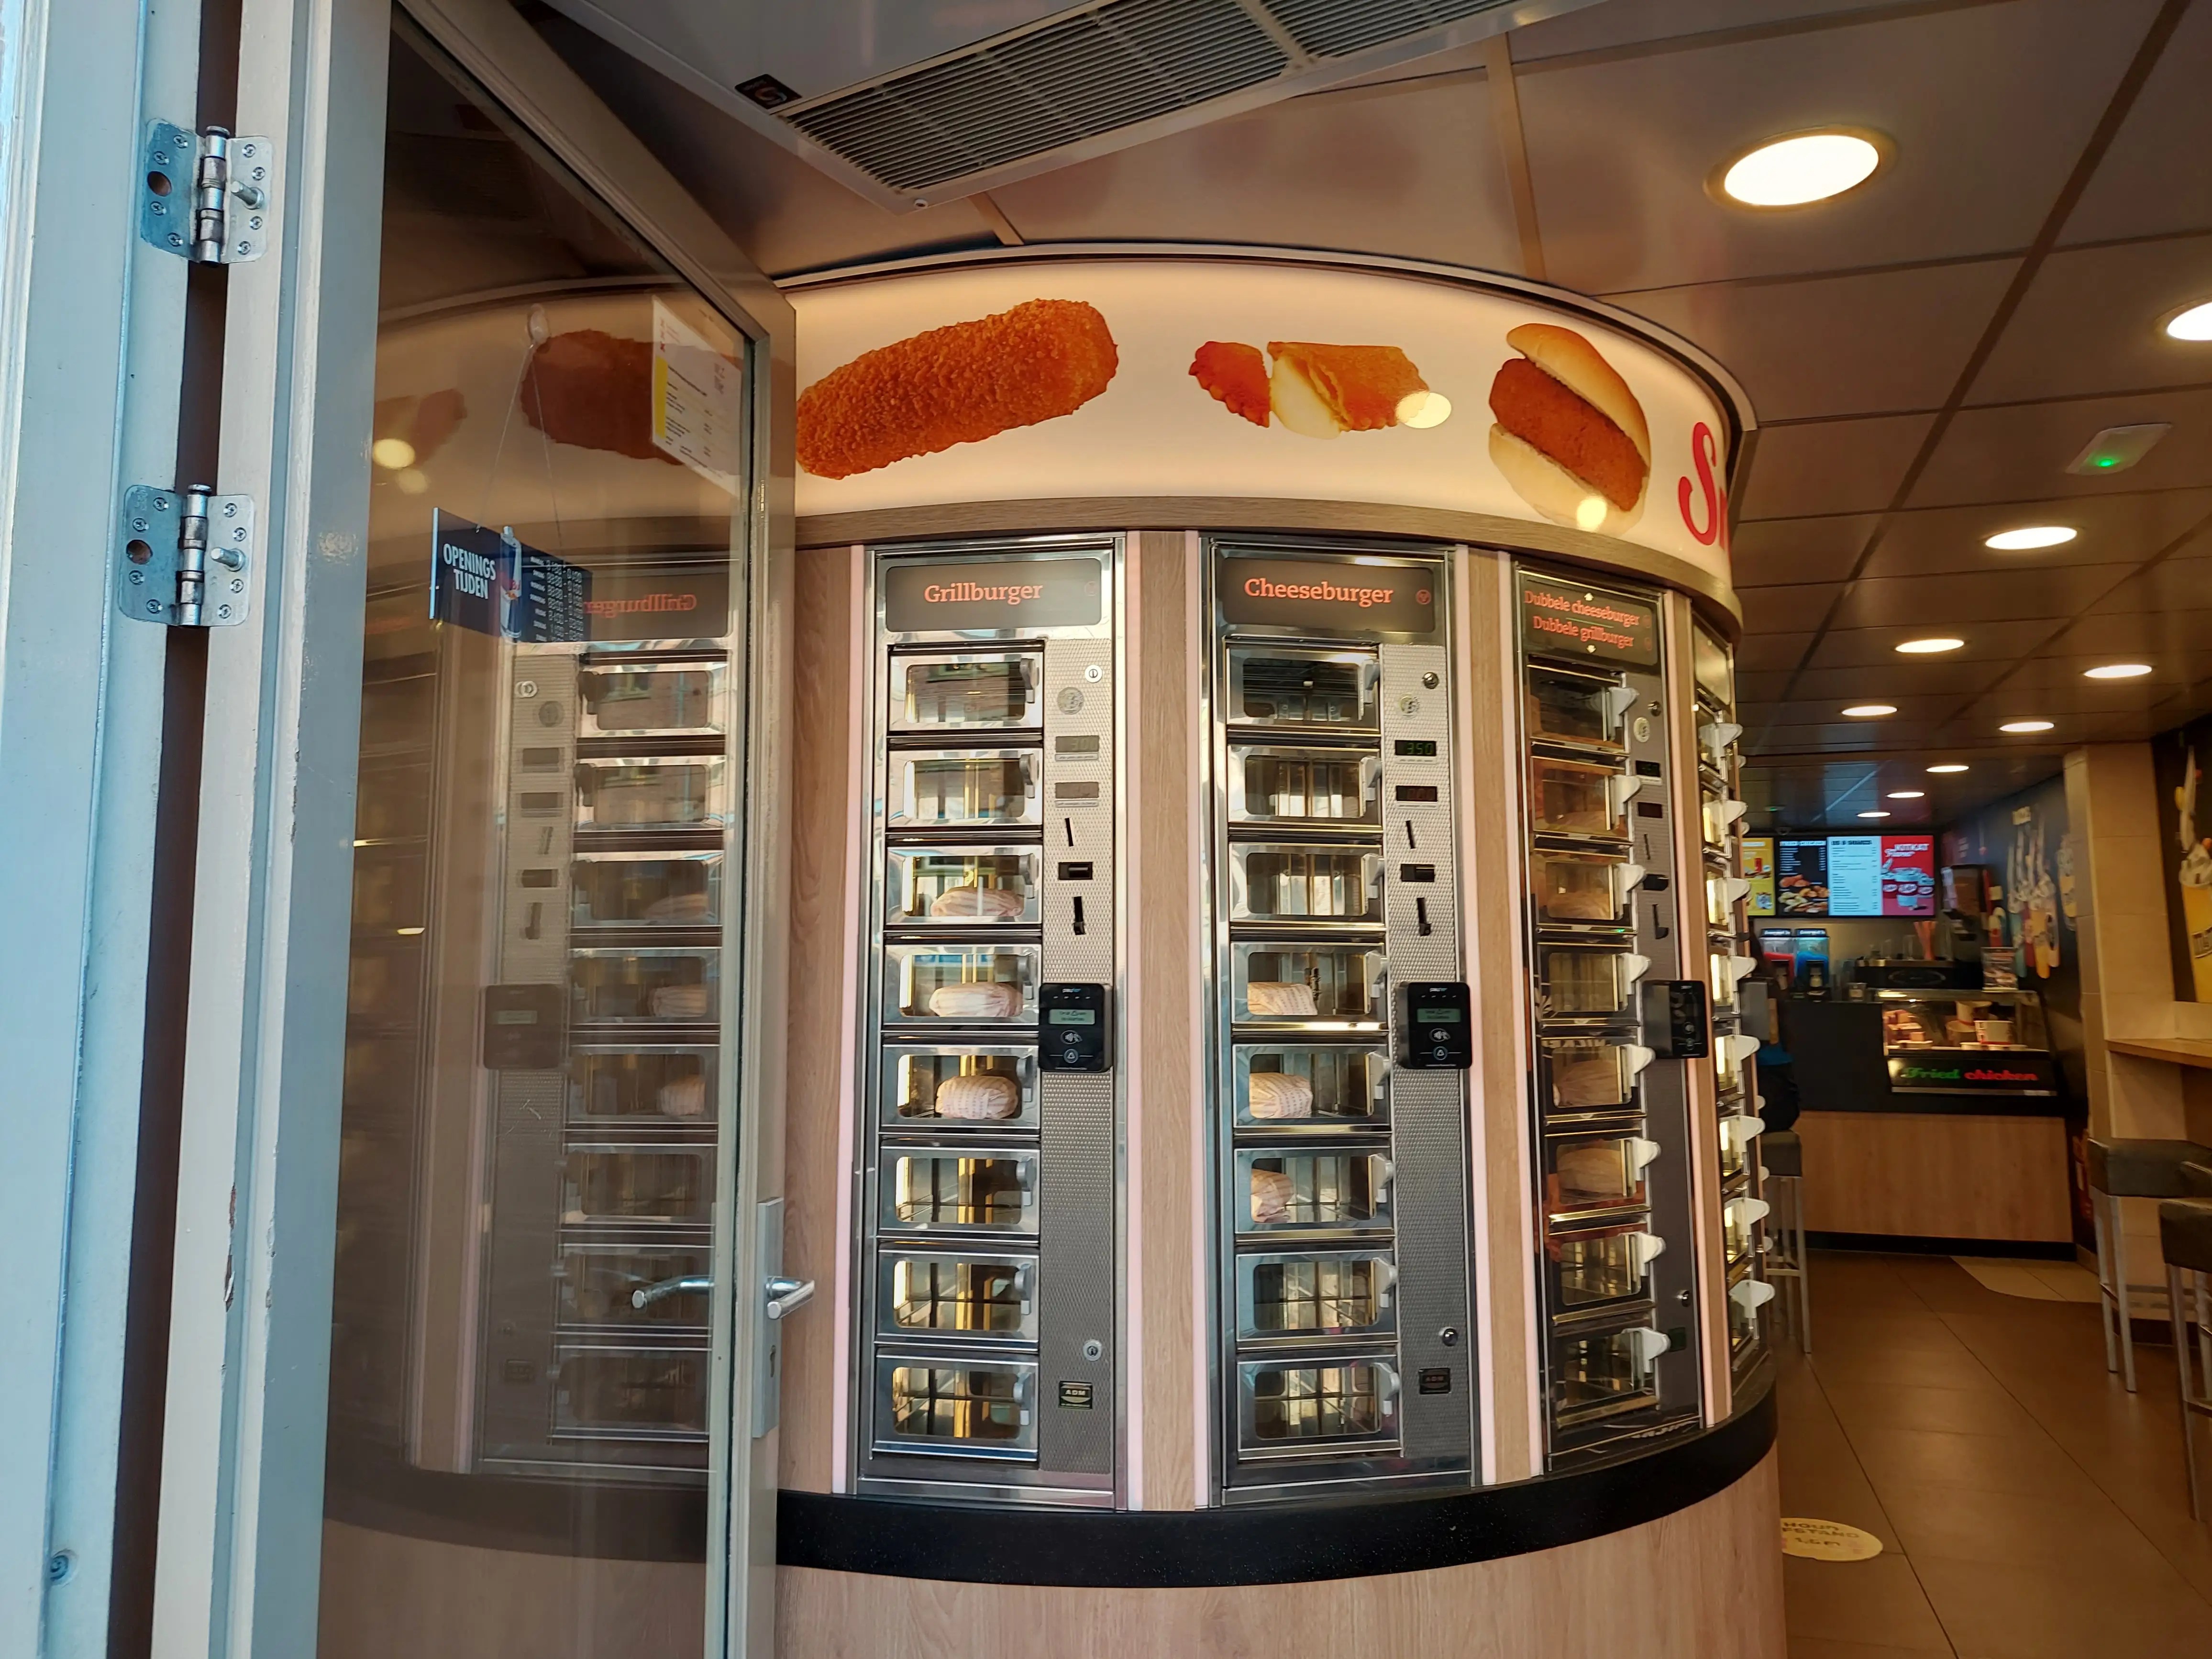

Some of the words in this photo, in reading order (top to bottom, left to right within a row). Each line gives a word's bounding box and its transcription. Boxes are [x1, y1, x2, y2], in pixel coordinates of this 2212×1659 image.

[443, 543, 496, 581] OPENINGS
[453, 568, 488, 599] TIJDEN
[924, 582, 1043, 605] Grillburger
[1244, 577, 1394, 608] Cheeseburger
[1524, 591, 1571, 612] Dubbele
[1571, 600, 1640, 628] cheeseburger
[1533, 616, 1579, 636] Dubbele
[1580, 626, 1634, 649] grillburger
[1901, 1067, 1960, 1079] Fried
[1964, 1069, 2039, 1081] chicken
